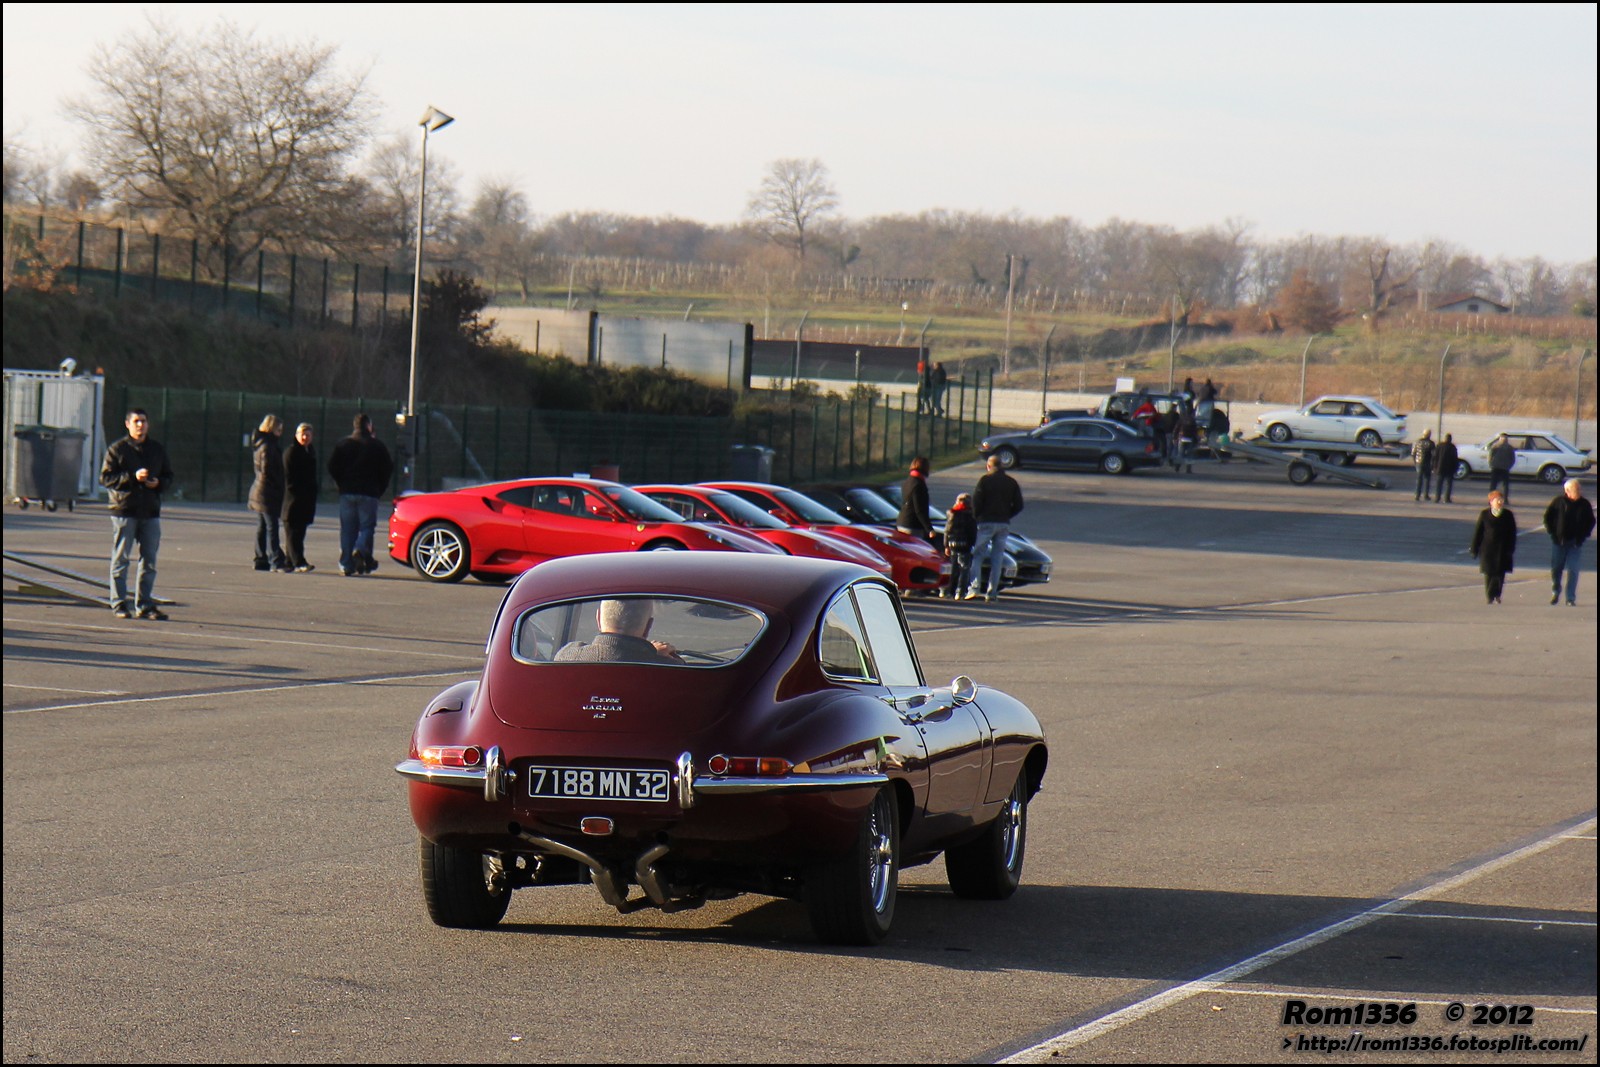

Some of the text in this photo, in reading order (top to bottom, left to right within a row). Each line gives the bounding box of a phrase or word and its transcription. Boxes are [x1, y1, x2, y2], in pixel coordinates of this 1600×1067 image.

[532, 769, 667, 798] 7188 MN 32
